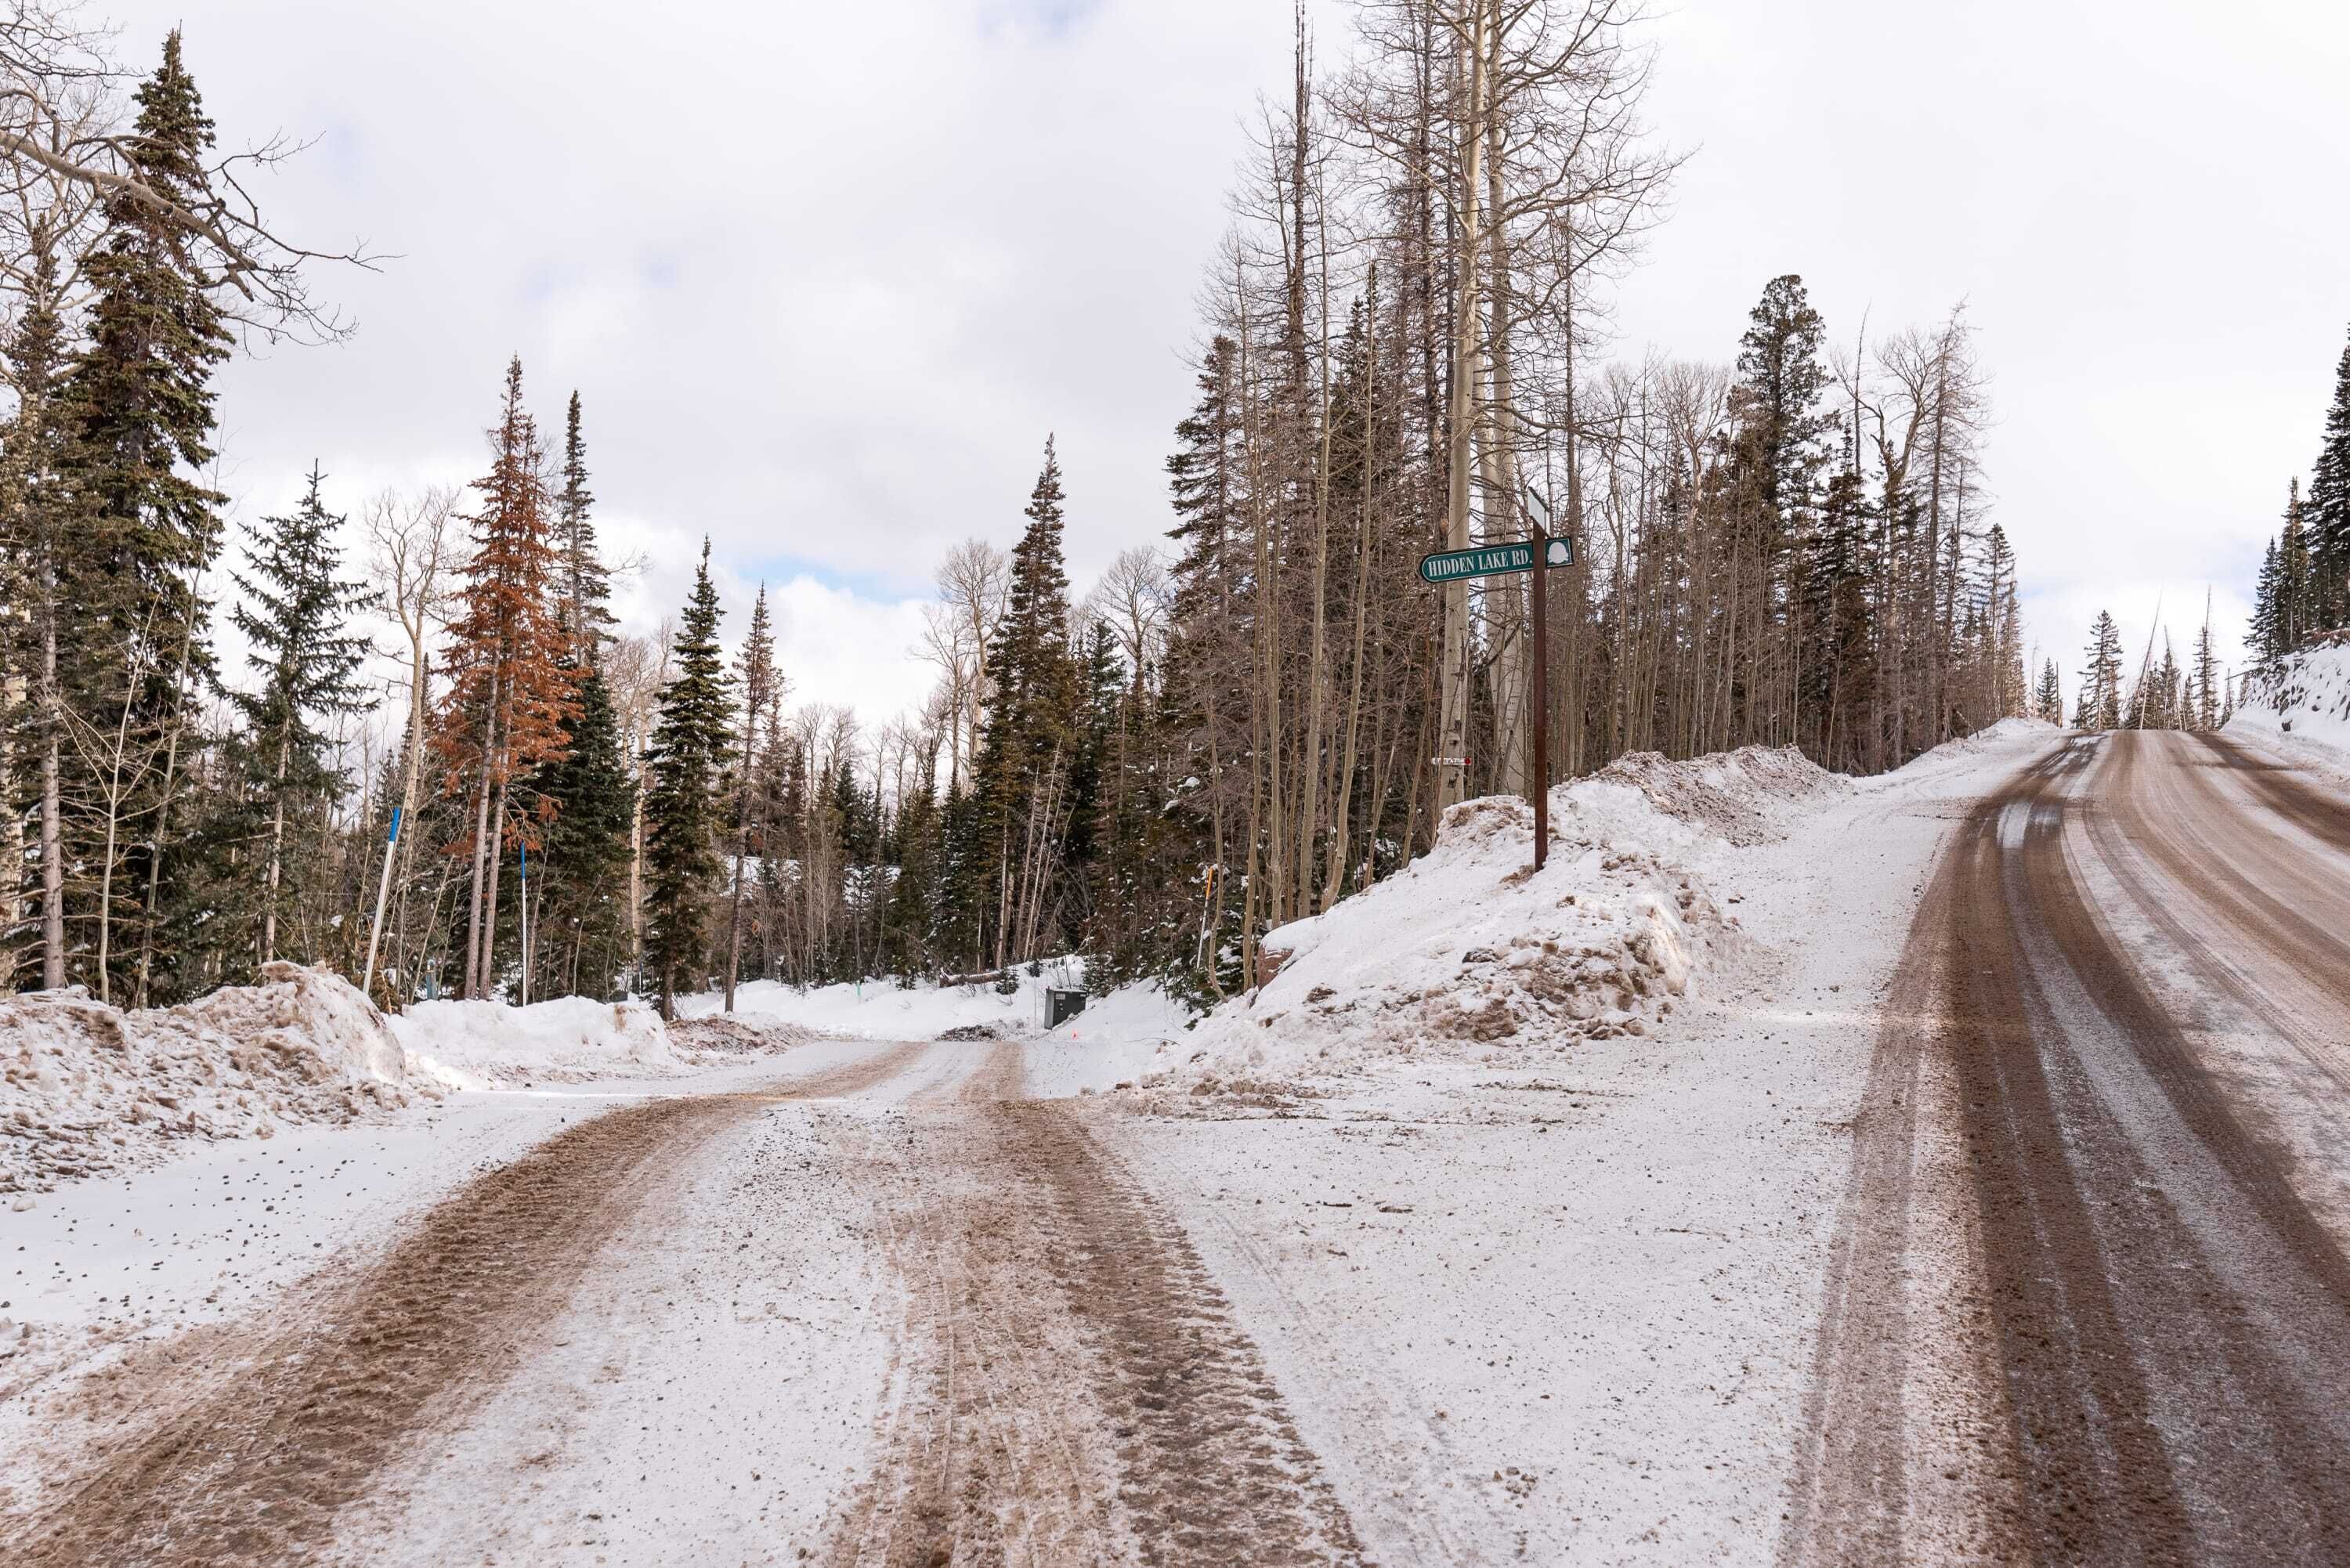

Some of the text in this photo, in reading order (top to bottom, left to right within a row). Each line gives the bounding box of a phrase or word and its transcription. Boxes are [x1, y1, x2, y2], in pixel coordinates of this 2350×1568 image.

[1429, 549, 1533, 577] HIDDEN LAKE RD.
